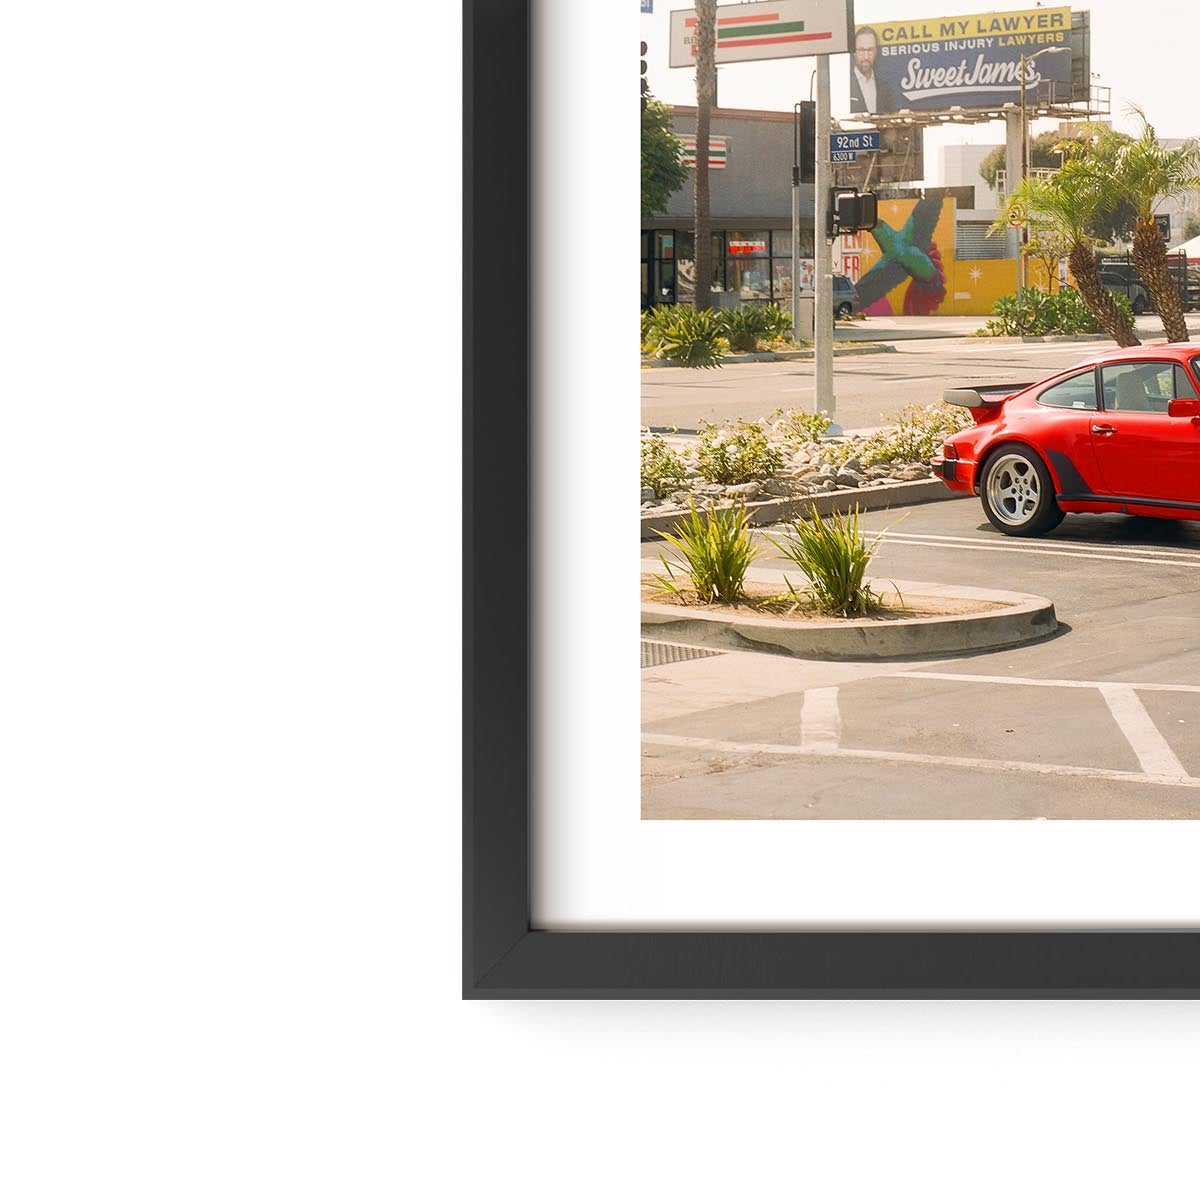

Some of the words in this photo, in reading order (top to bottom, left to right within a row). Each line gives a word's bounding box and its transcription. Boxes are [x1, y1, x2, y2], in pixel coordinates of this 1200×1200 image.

[882, 24, 932, 41] CALL
[940, 20, 969, 37] MY
[977, 13, 1064, 33] LAWYER
[881, 42, 940, 56] SERIOUS
[944, 38, 994, 52] INJURY
[998, 32, 1065, 47] LAWYERS
[836, 136, 860, 149] 92nd
[862, 134, 873, 148] St
